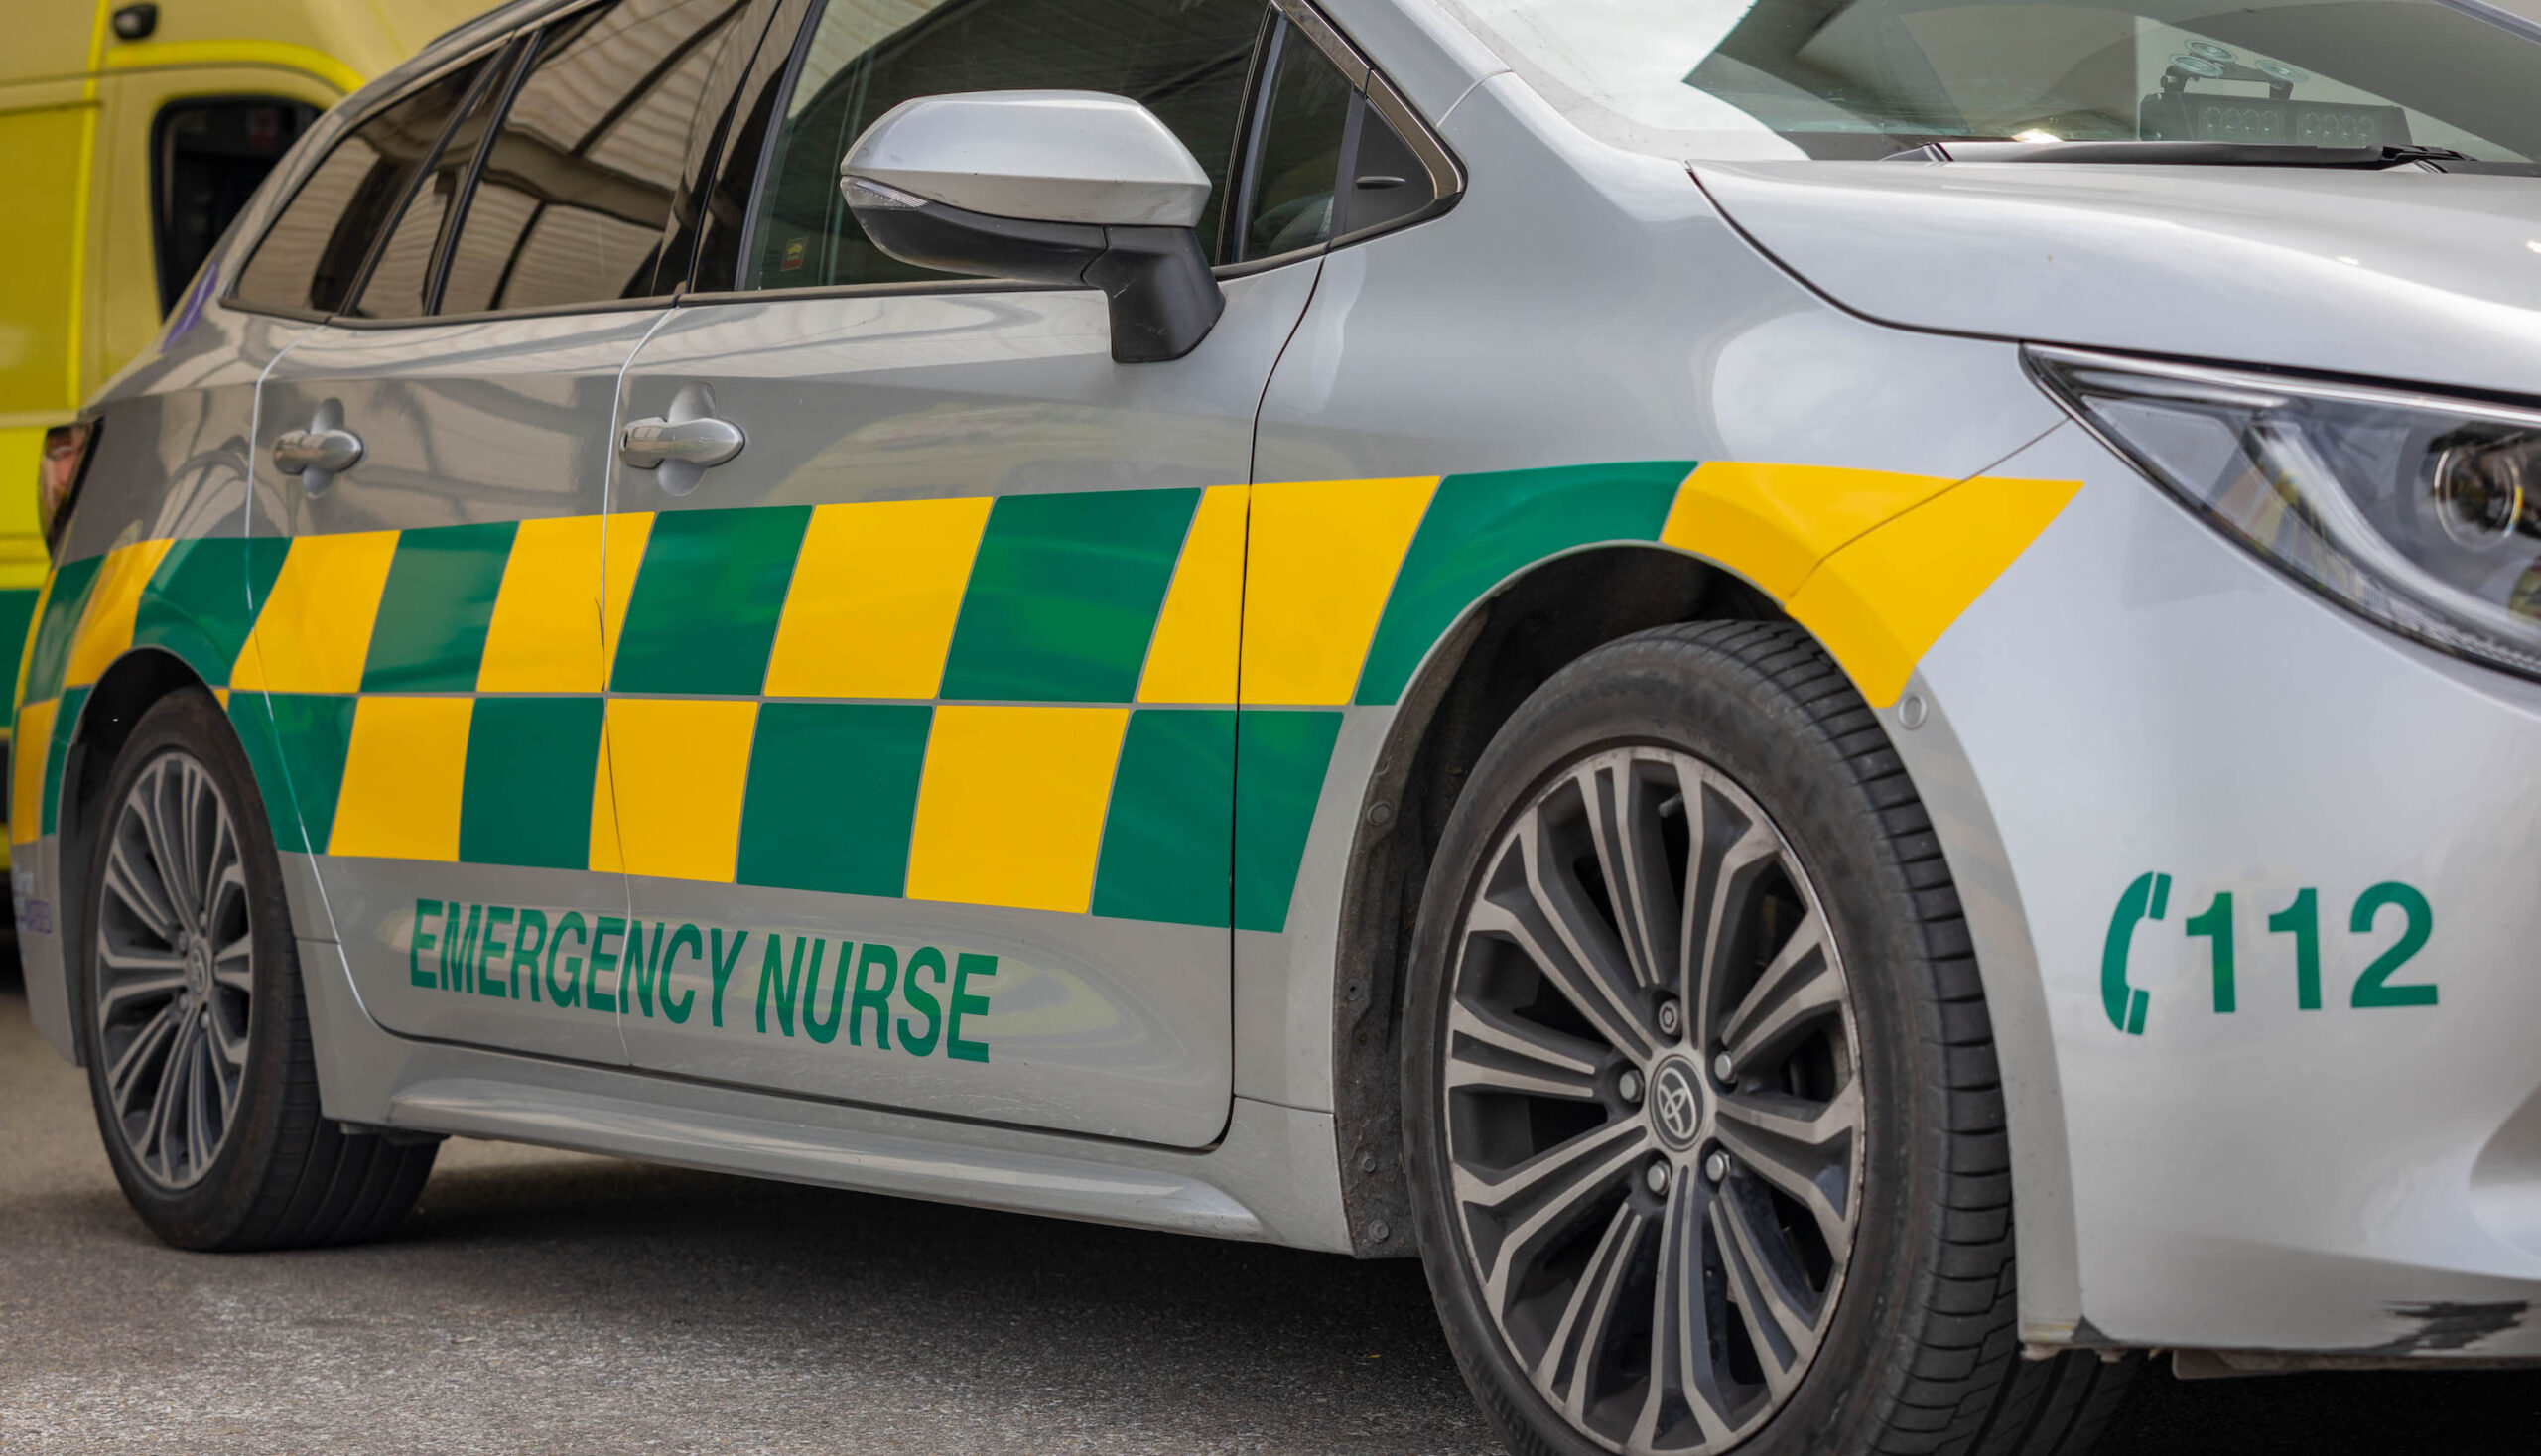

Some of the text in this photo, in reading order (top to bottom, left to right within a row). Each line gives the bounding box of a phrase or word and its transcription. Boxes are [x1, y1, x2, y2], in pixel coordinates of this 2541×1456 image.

[410, 898, 999, 1063] EMERGENCY NURSE
[2186, 881, 2439, 1013] 112
